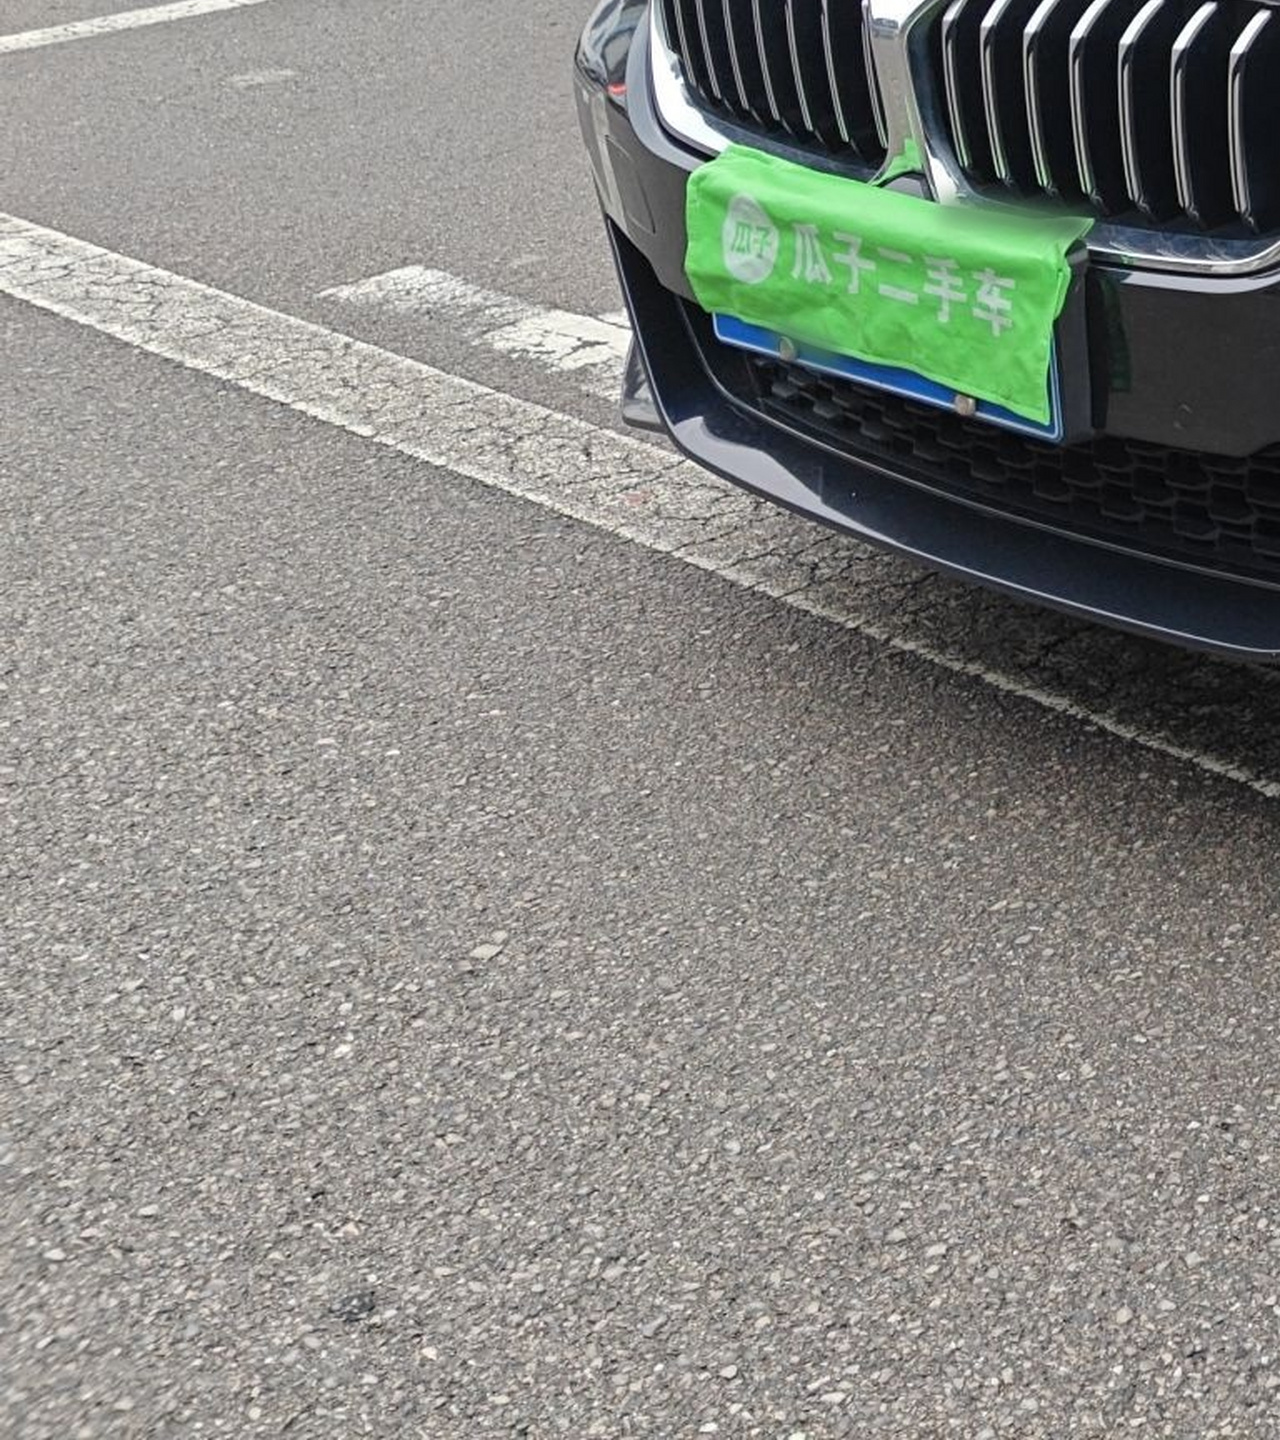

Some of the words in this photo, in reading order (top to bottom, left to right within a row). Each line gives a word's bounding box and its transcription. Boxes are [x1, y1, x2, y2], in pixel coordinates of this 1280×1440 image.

[731, 221, 773, 259] 瓜子
[791, 221, 1016, 337] 瓜子二手车
